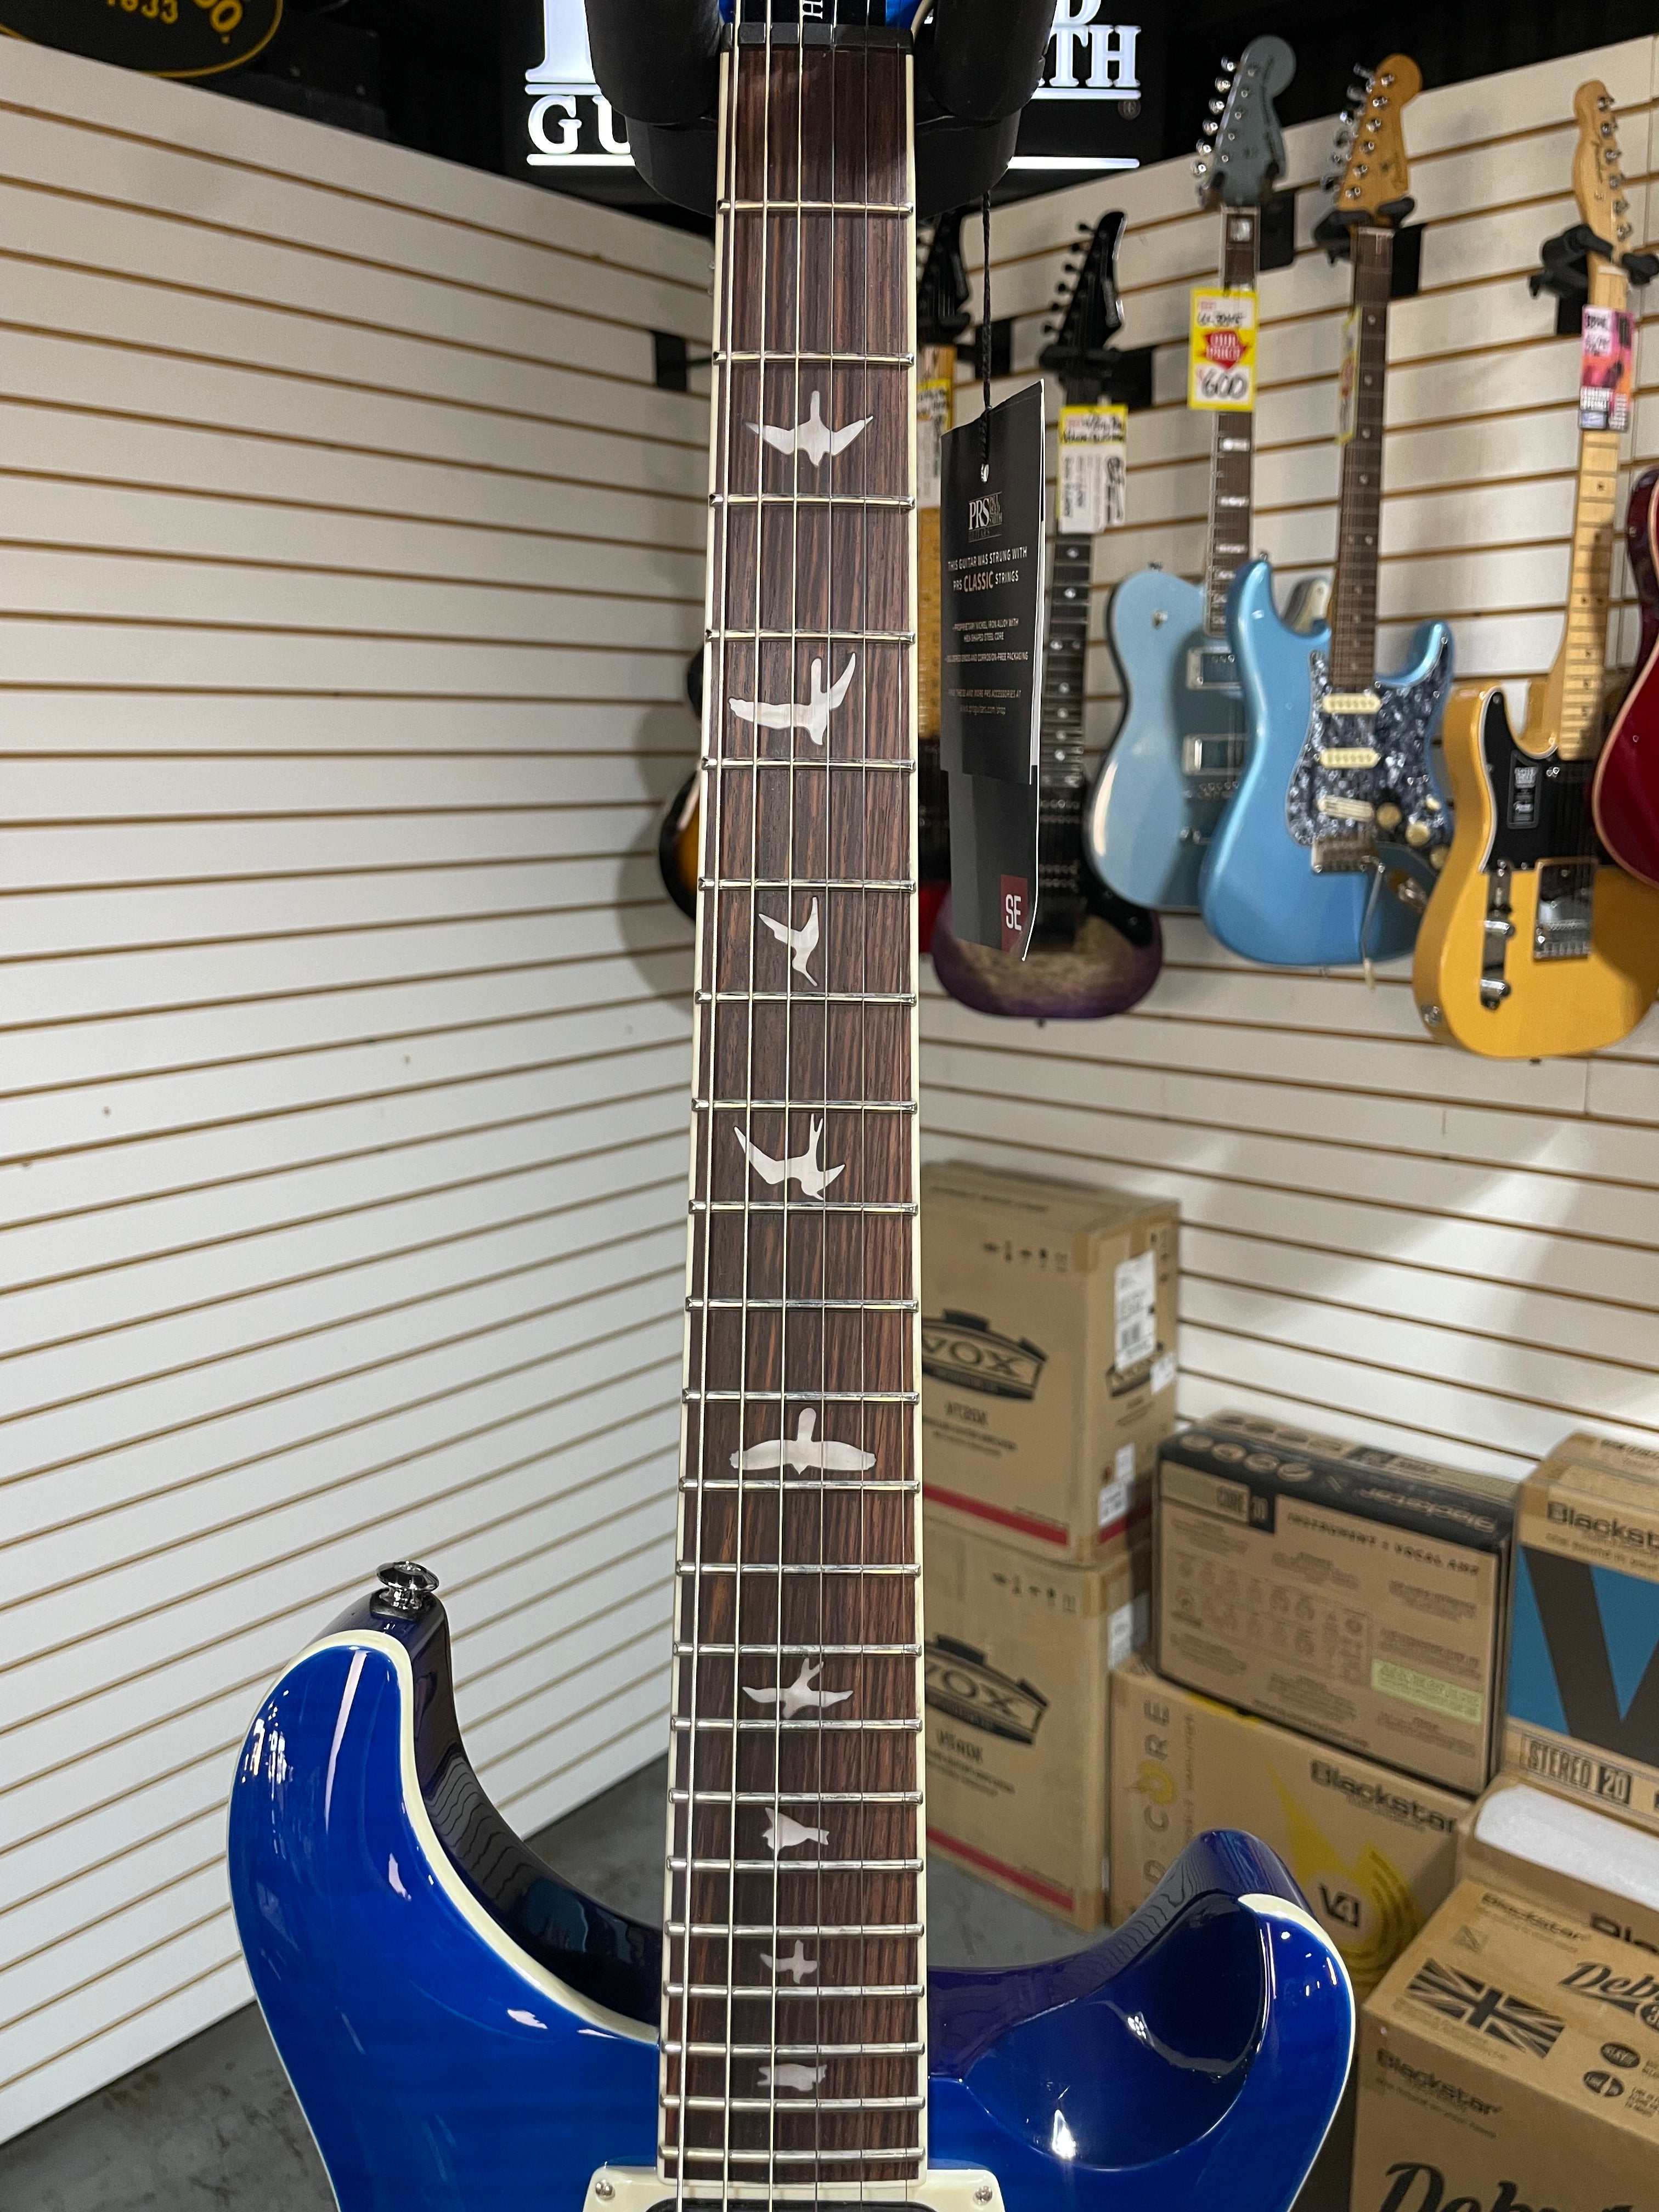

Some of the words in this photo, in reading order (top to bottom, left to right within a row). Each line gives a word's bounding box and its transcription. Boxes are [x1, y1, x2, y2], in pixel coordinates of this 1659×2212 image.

[969, 498, 989, 531] PRS
[948, 559, 958, 572] THIS
[959, 556, 977, 569] GUITAR
[978, 554, 988, 566] WAS
[990, 549, 1011, 564] STRUNG
[1012, 546, 1028, 560] WITH
[953, 579, 962, 591] PRS
[963, 571, 994, 592] CLASSIC
[995, 570, 1019, 585] STRINGS
[1005, 894, 1022, 932] SE
[922, 1336, 1024, 1378] VOX
[1547, 1500, 1659, 1549] Blackst
[1527, 1739, 1592, 1790] STEREO
[1601, 1767, 1628, 1801] 20
[1557, 1961, 1659, 2000] Deb
